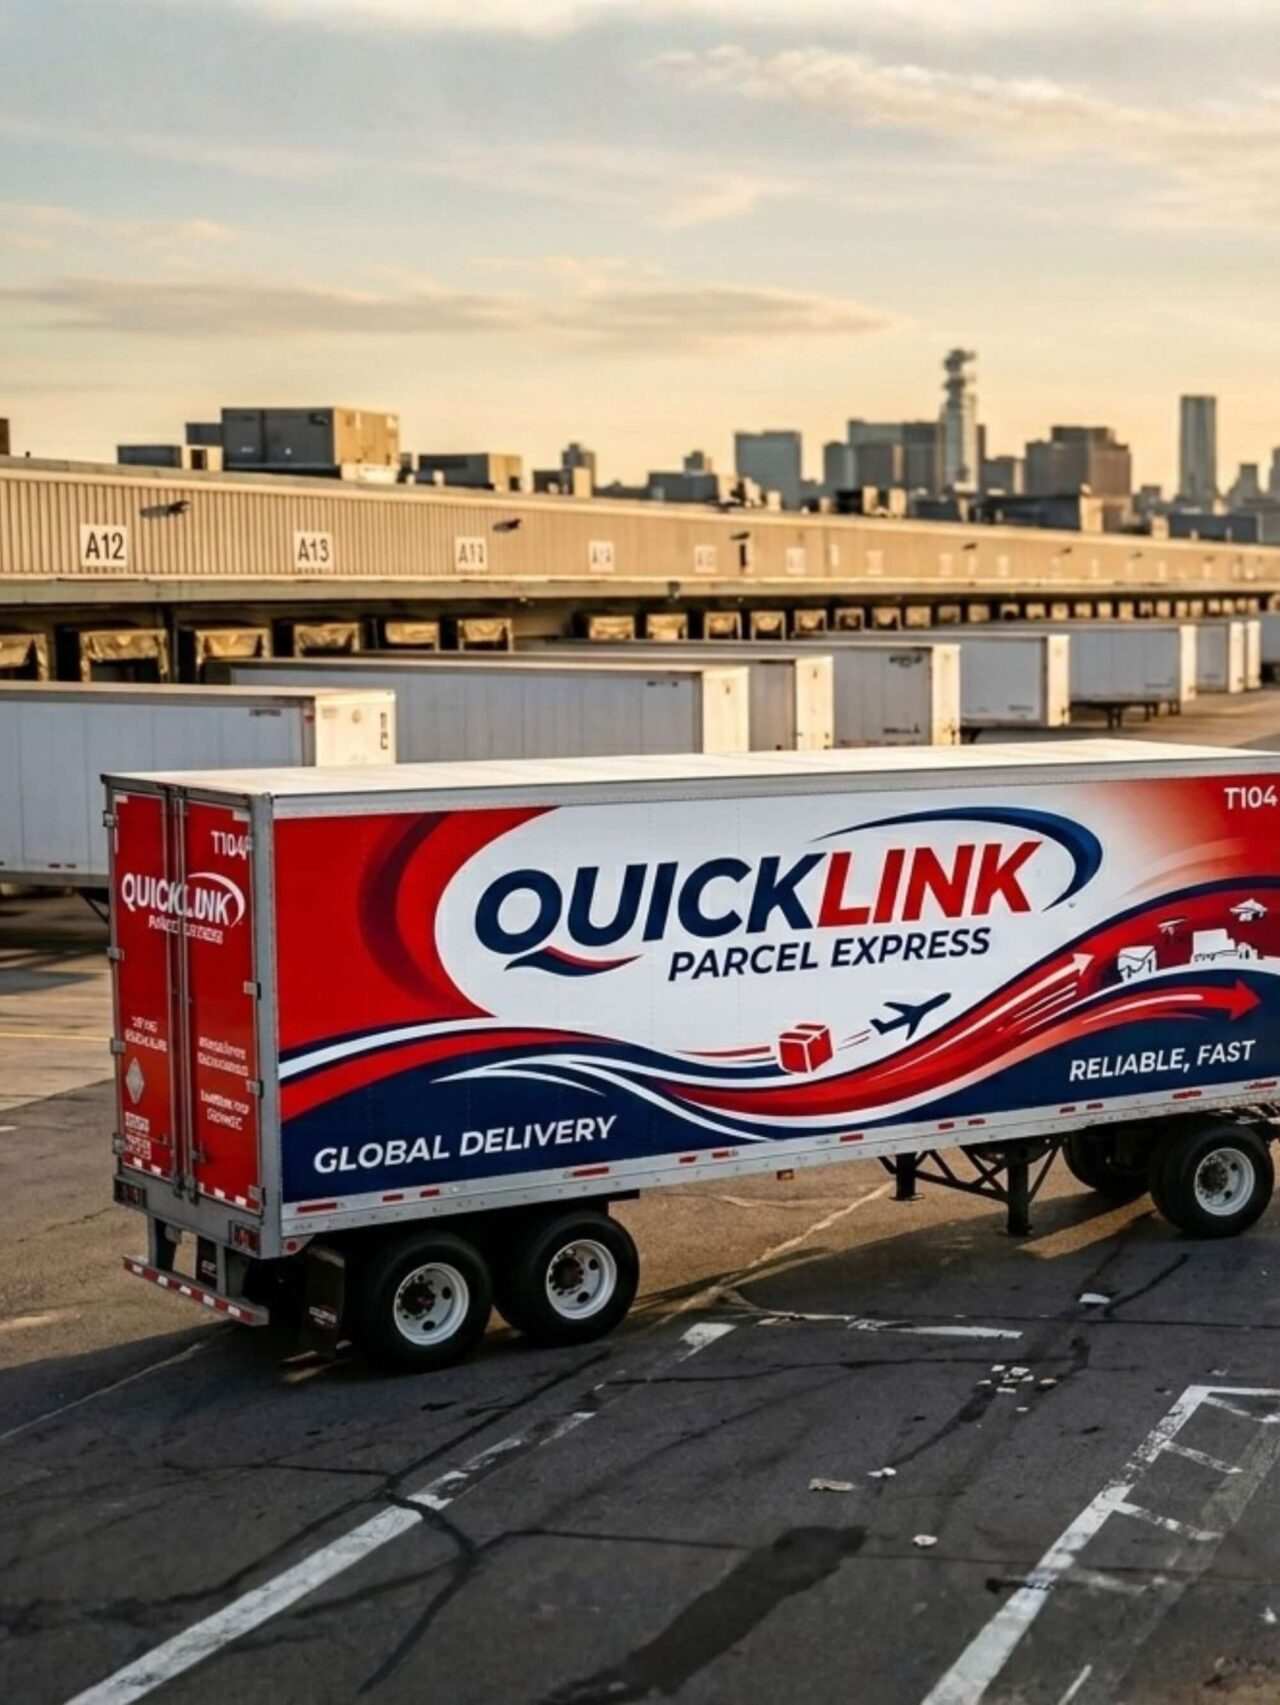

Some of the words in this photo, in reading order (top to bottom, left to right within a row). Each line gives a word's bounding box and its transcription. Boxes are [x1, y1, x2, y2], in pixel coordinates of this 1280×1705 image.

[85, 531, 125, 560] A12
[298, 536, 330, 562] A13
[474, 841, 1042, 977] QUICKLINK
[668, 941, 818, 981] PARCEL
[830, 927, 991, 967] EXPRESS
[1069, 1047, 1191, 1082] RELIABLE,
[1196, 1040, 1256, 1066] FAST
[313, 1135, 450, 1174] GLOBAL
[459, 1114, 617, 1157] DELIVERY
